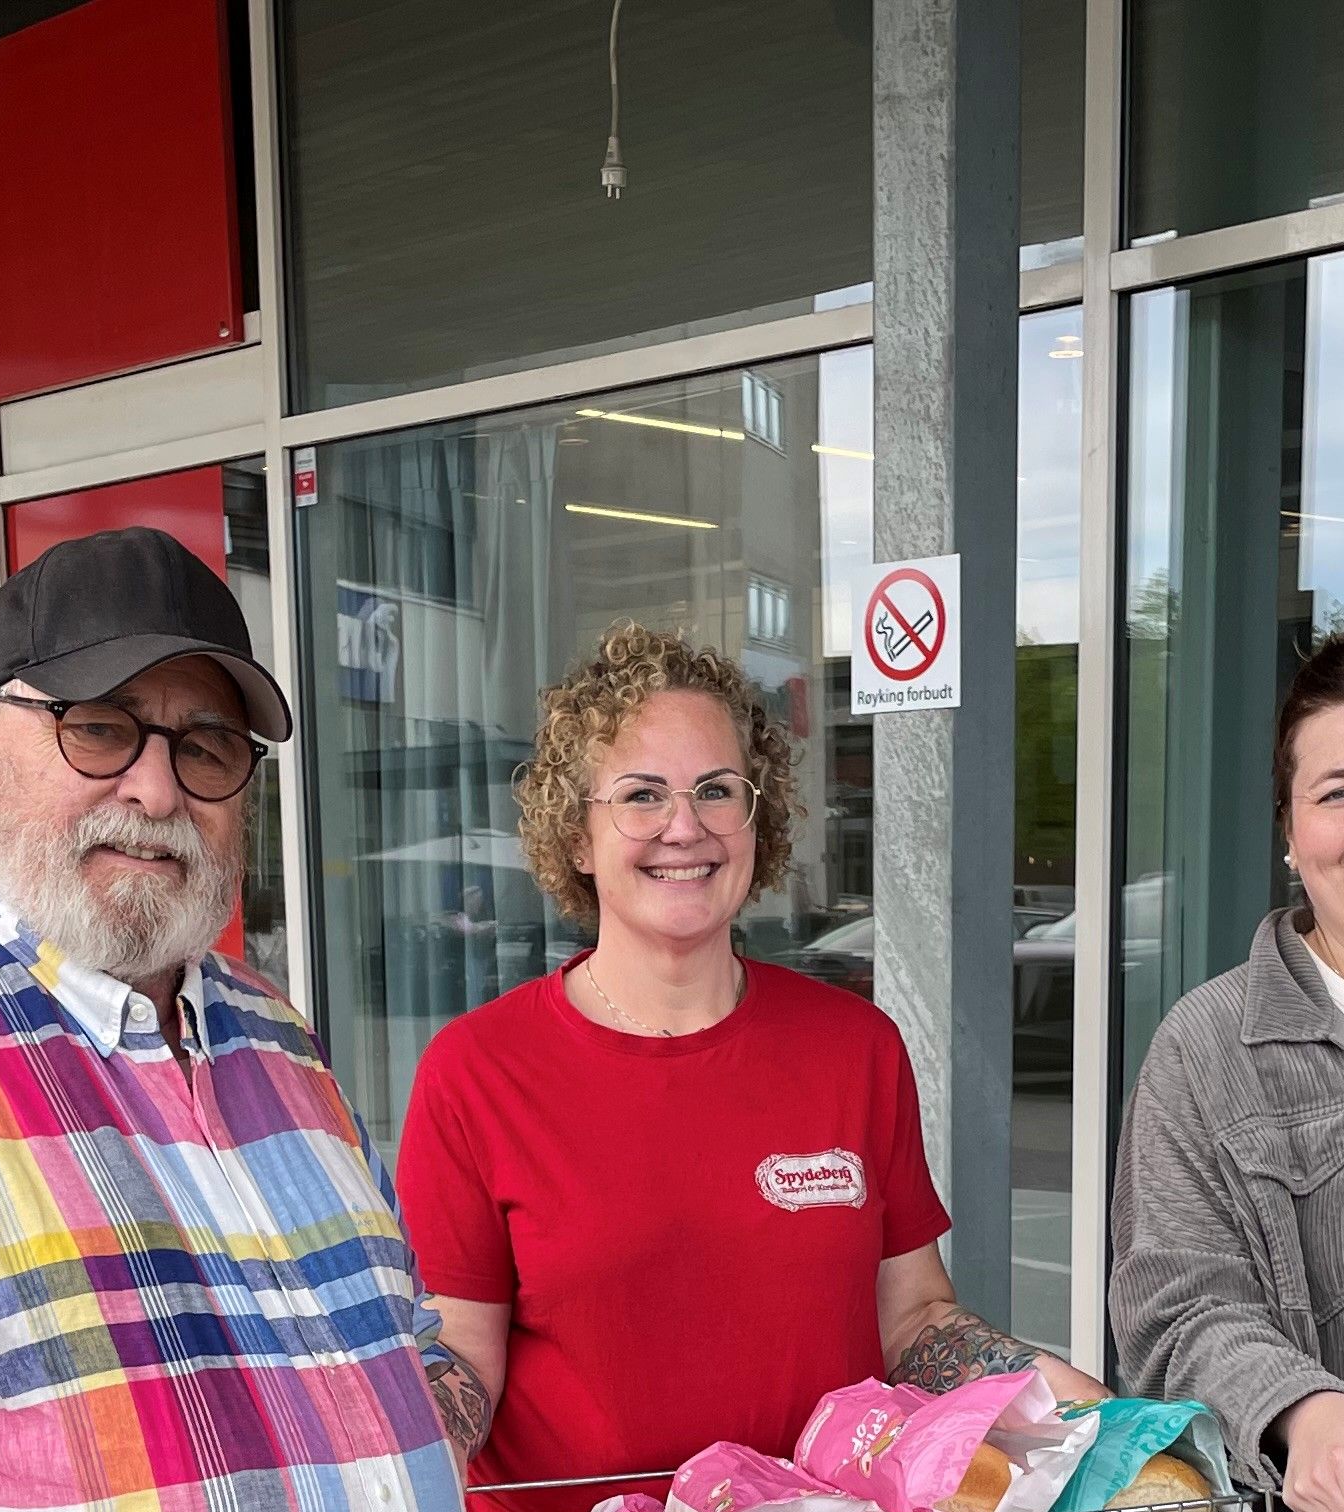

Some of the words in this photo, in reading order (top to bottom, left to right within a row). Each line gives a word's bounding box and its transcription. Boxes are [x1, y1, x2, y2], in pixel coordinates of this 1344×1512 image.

[857, 687, 904, 708] Røyking
[907, 684, 953, 702] forbudt
[775, 1166, 853, 1186] Spydeberg
